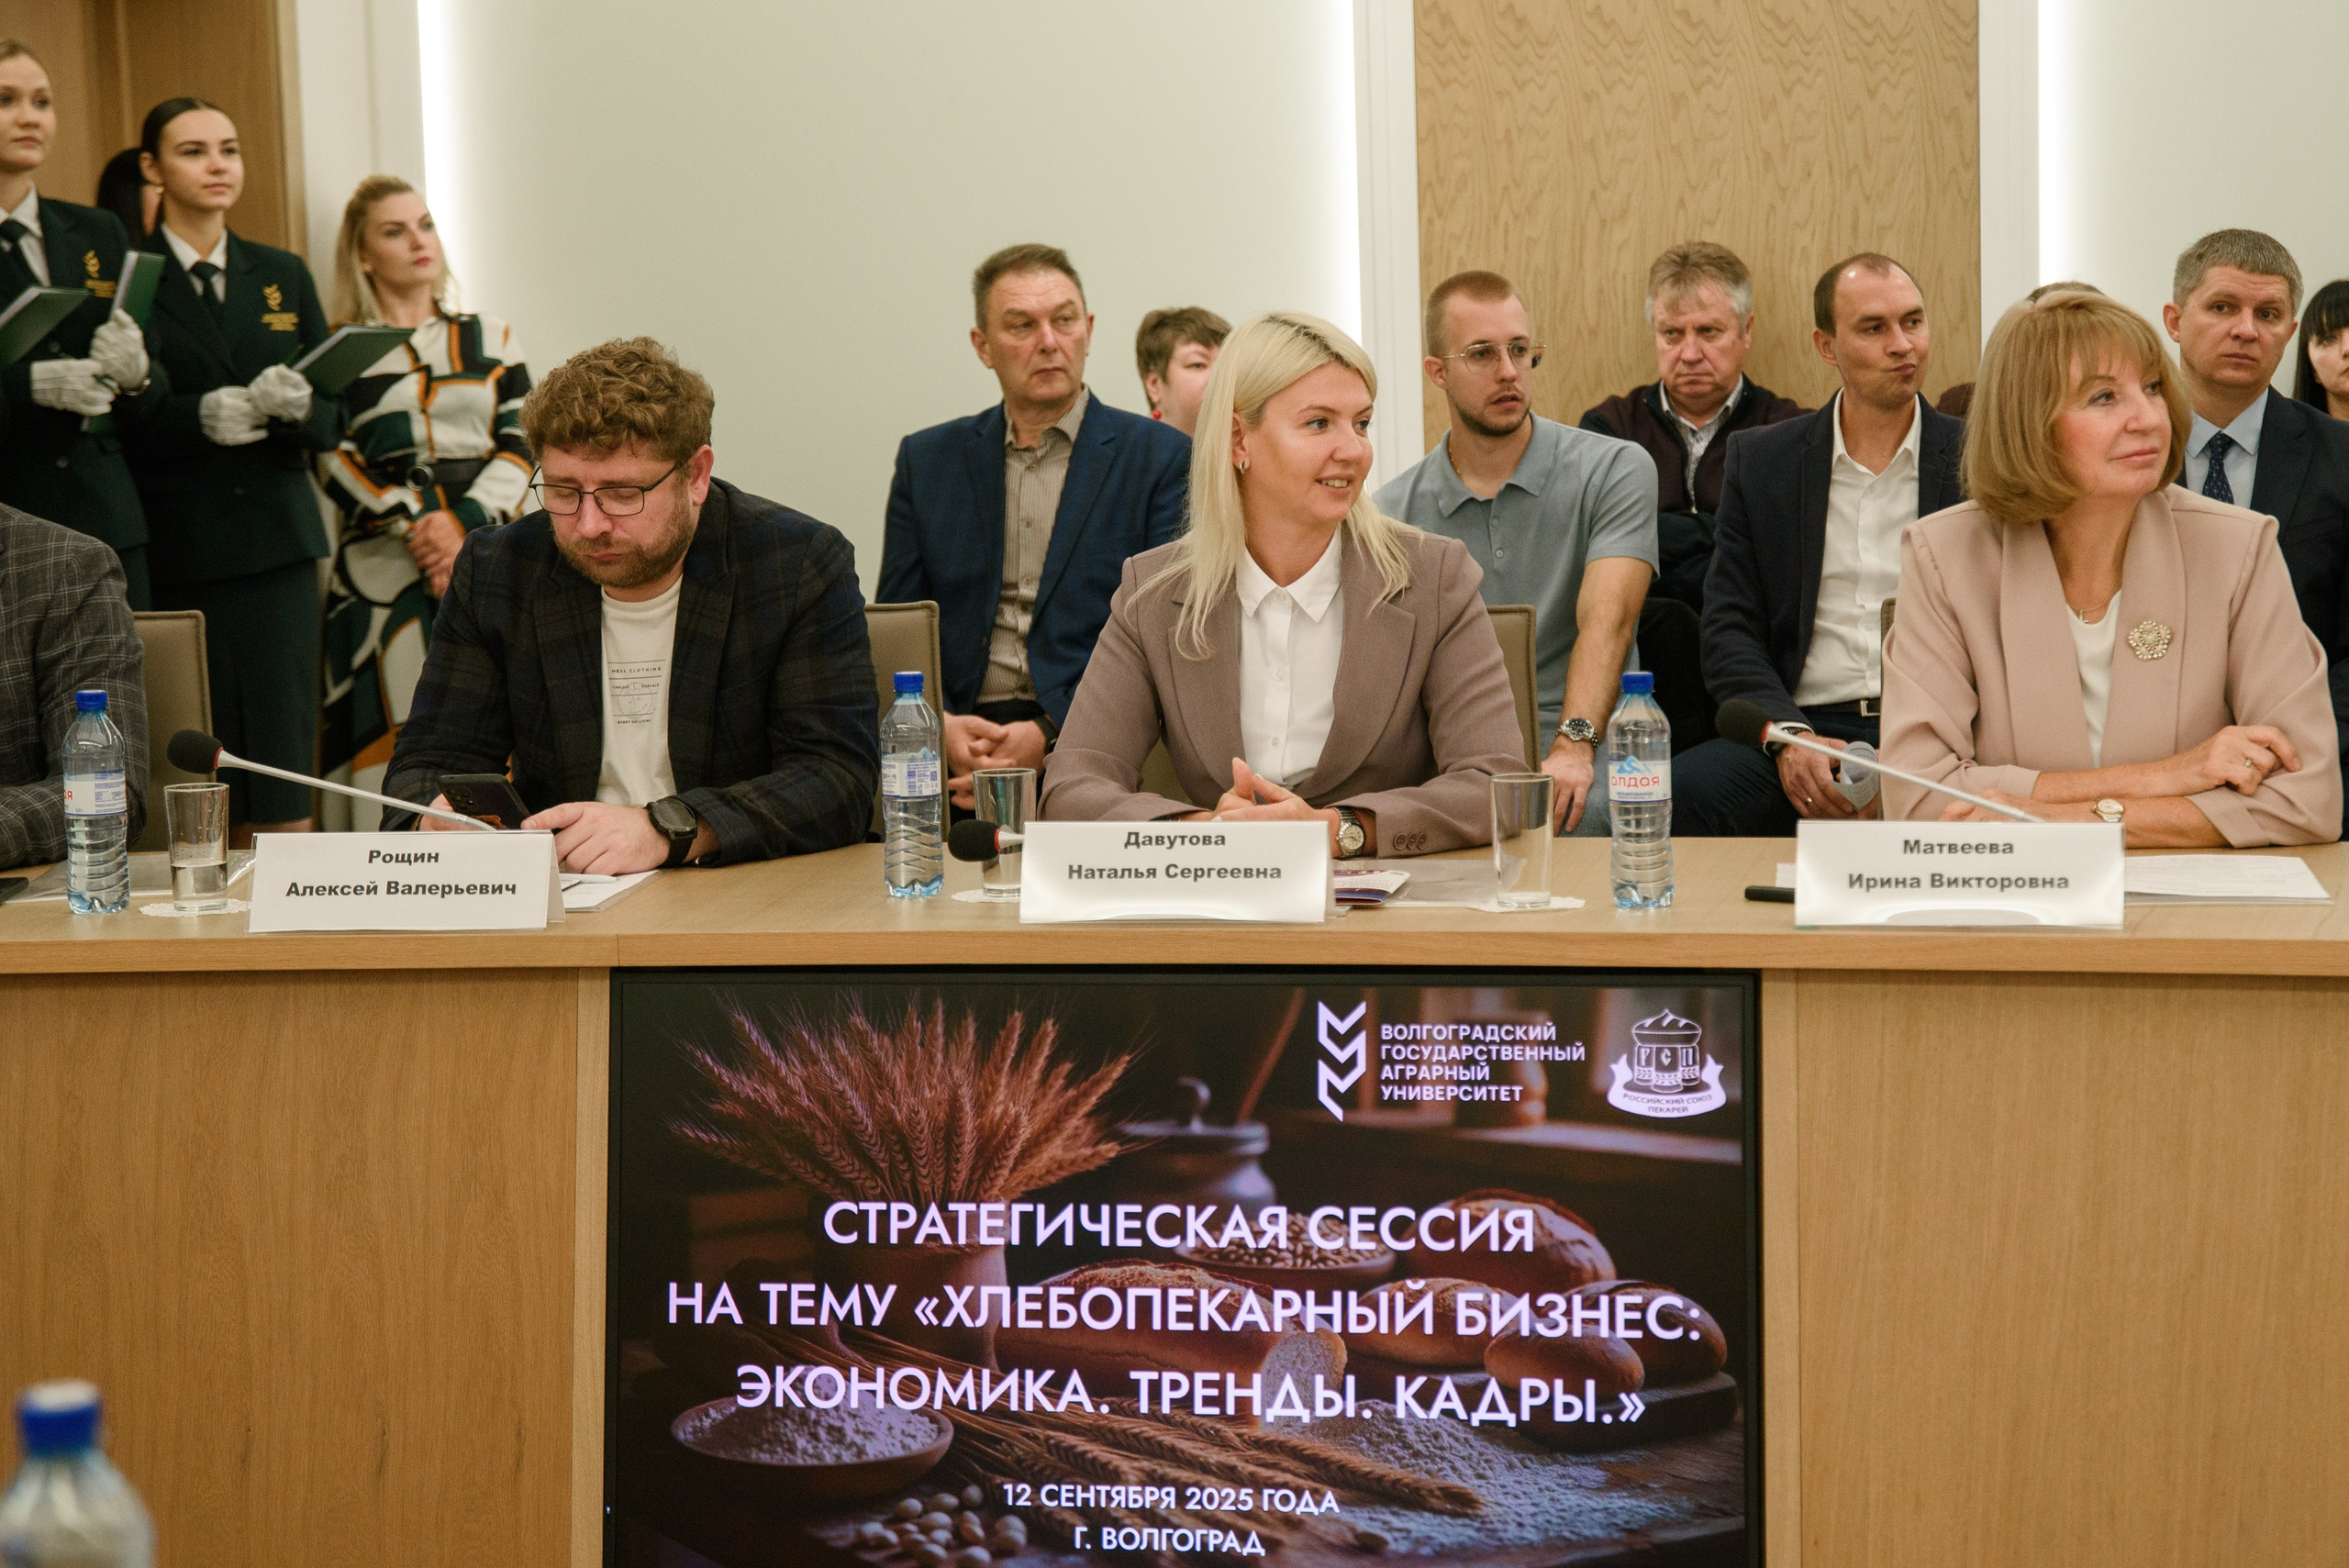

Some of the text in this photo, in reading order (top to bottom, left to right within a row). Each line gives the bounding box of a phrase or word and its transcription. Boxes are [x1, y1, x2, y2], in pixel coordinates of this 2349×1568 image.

[1124, 831, 1226, 850] Давутова
[1903, 839, 2014, 854] Матвеева
[368, 850, 440, 865] Рощин
[1067, 863, 1282, 882] Наталья Сергеевна
[285, 881, 517, 898] Алексей Валерьевич
[1848, 873, 2070, 893] Ирина Викторовна
[1380, 1021, 1556, 1042] ВОЛГОГРАДСКИЙ
[1380, 1041, 1586, 1062] ГОСУДАРСТВЕННЫЙ
[1380, 1062, 1490, 1081] АГРАРНЫЙ
[1380, 1084, 1523, 1101] УНИВЕРСИТЕТ
[1622, 1093, 1713, 1105] РОССИЙСКИЙ СОЮЗ
[823, 1200, 1534, 1252] СТРАТЕГИЧЕСКАЯ СЕССИЯ
[668, 1278, 1701, 1340] НА ТЕМУ «ХЛЕБОПЕКАРНЫЙ БИЗНЕС:
[736, 1364, 1646, 1428] ЭКОНОМИКА. ТРЕНДЫ. КАДРЫ.»
[1003, 1484, 1341, 1515] 12 СЕНТЯБРЯ 2025 ГОДА
[1074, 1526, 1265, 1556] Г. ВОЛГОГРАД
